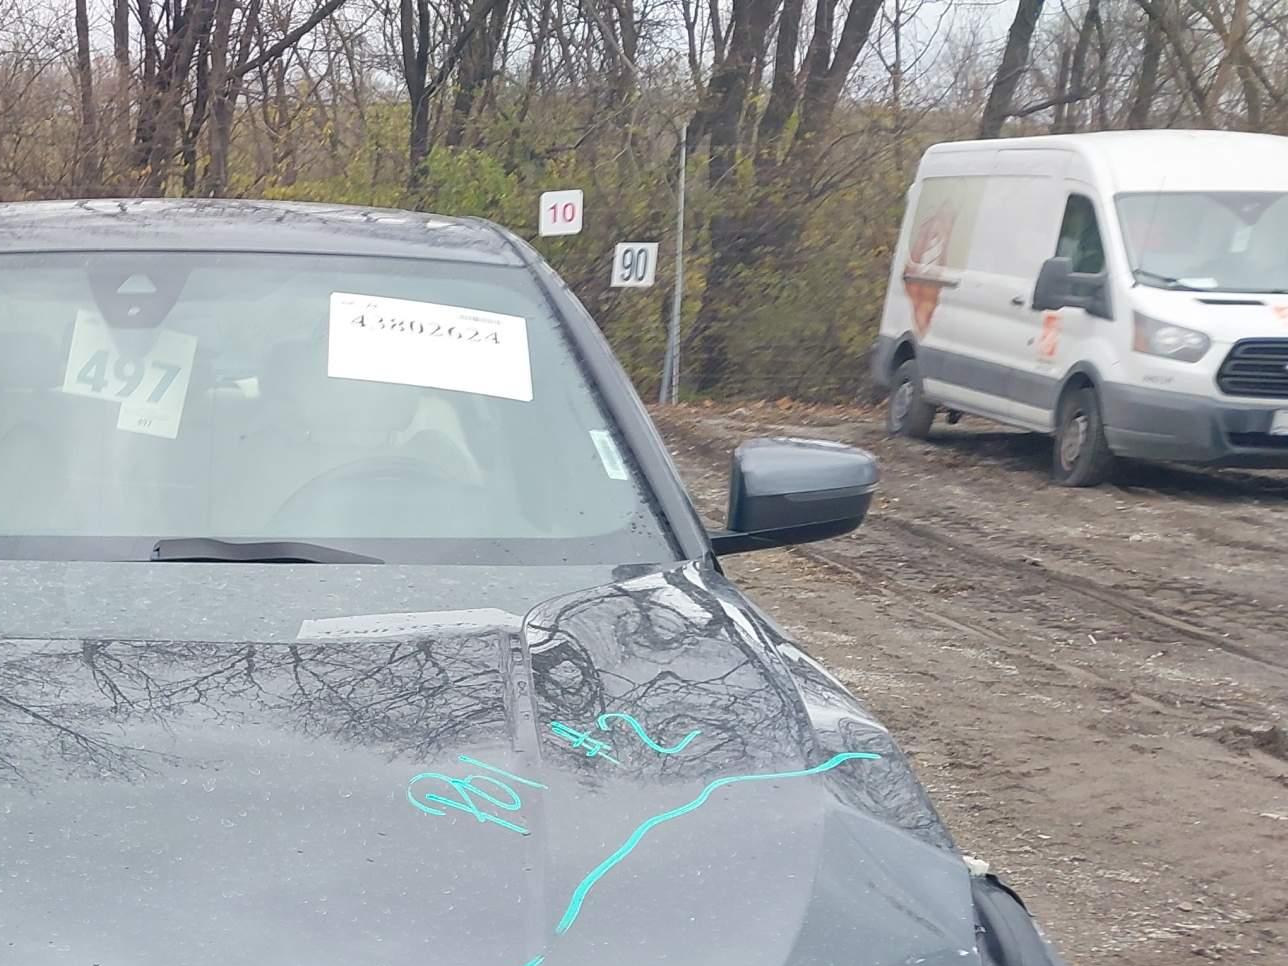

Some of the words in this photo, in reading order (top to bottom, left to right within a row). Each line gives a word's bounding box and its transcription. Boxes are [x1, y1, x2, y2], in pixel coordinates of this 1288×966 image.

[548, 202, 576, 224] 10
[620, 247, 648, 282] 90
[75, 348, 183, 404] 497
